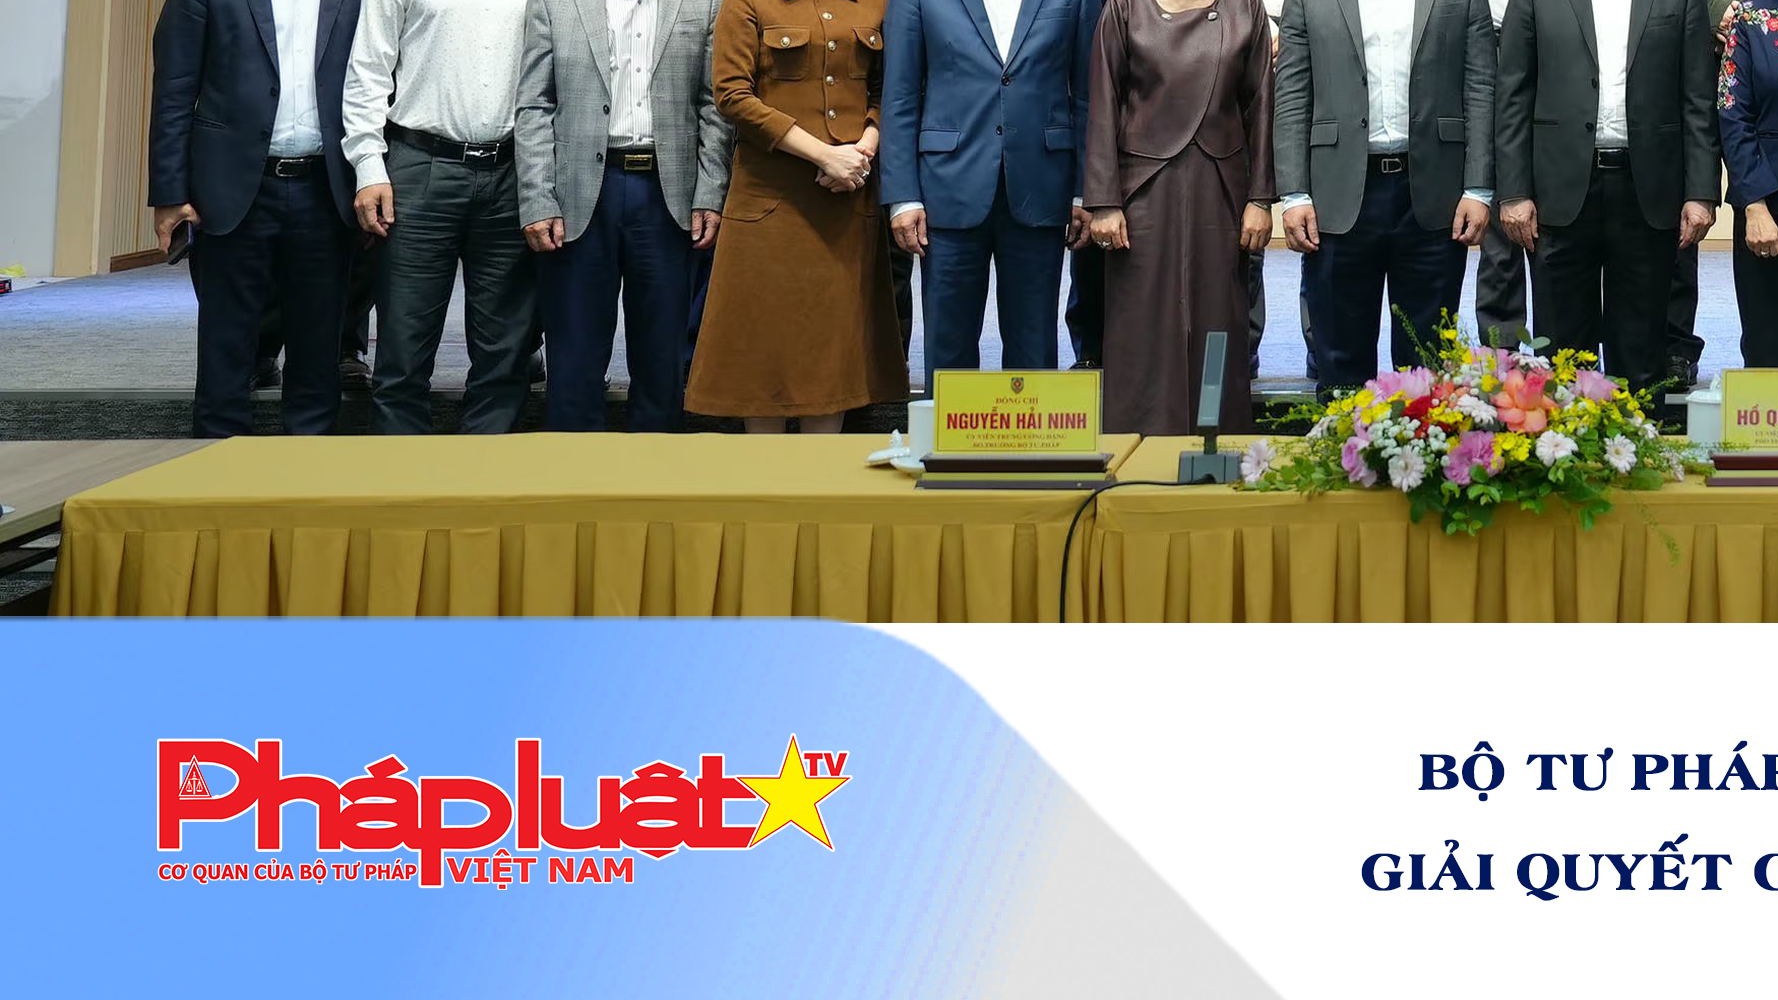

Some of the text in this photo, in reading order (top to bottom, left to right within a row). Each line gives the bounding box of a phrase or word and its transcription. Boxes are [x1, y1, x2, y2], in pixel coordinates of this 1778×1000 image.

[946, 406, 1087, 429] NGUYỄN HẢI NINH
[1737, 403, 1760, 426] HỒ
